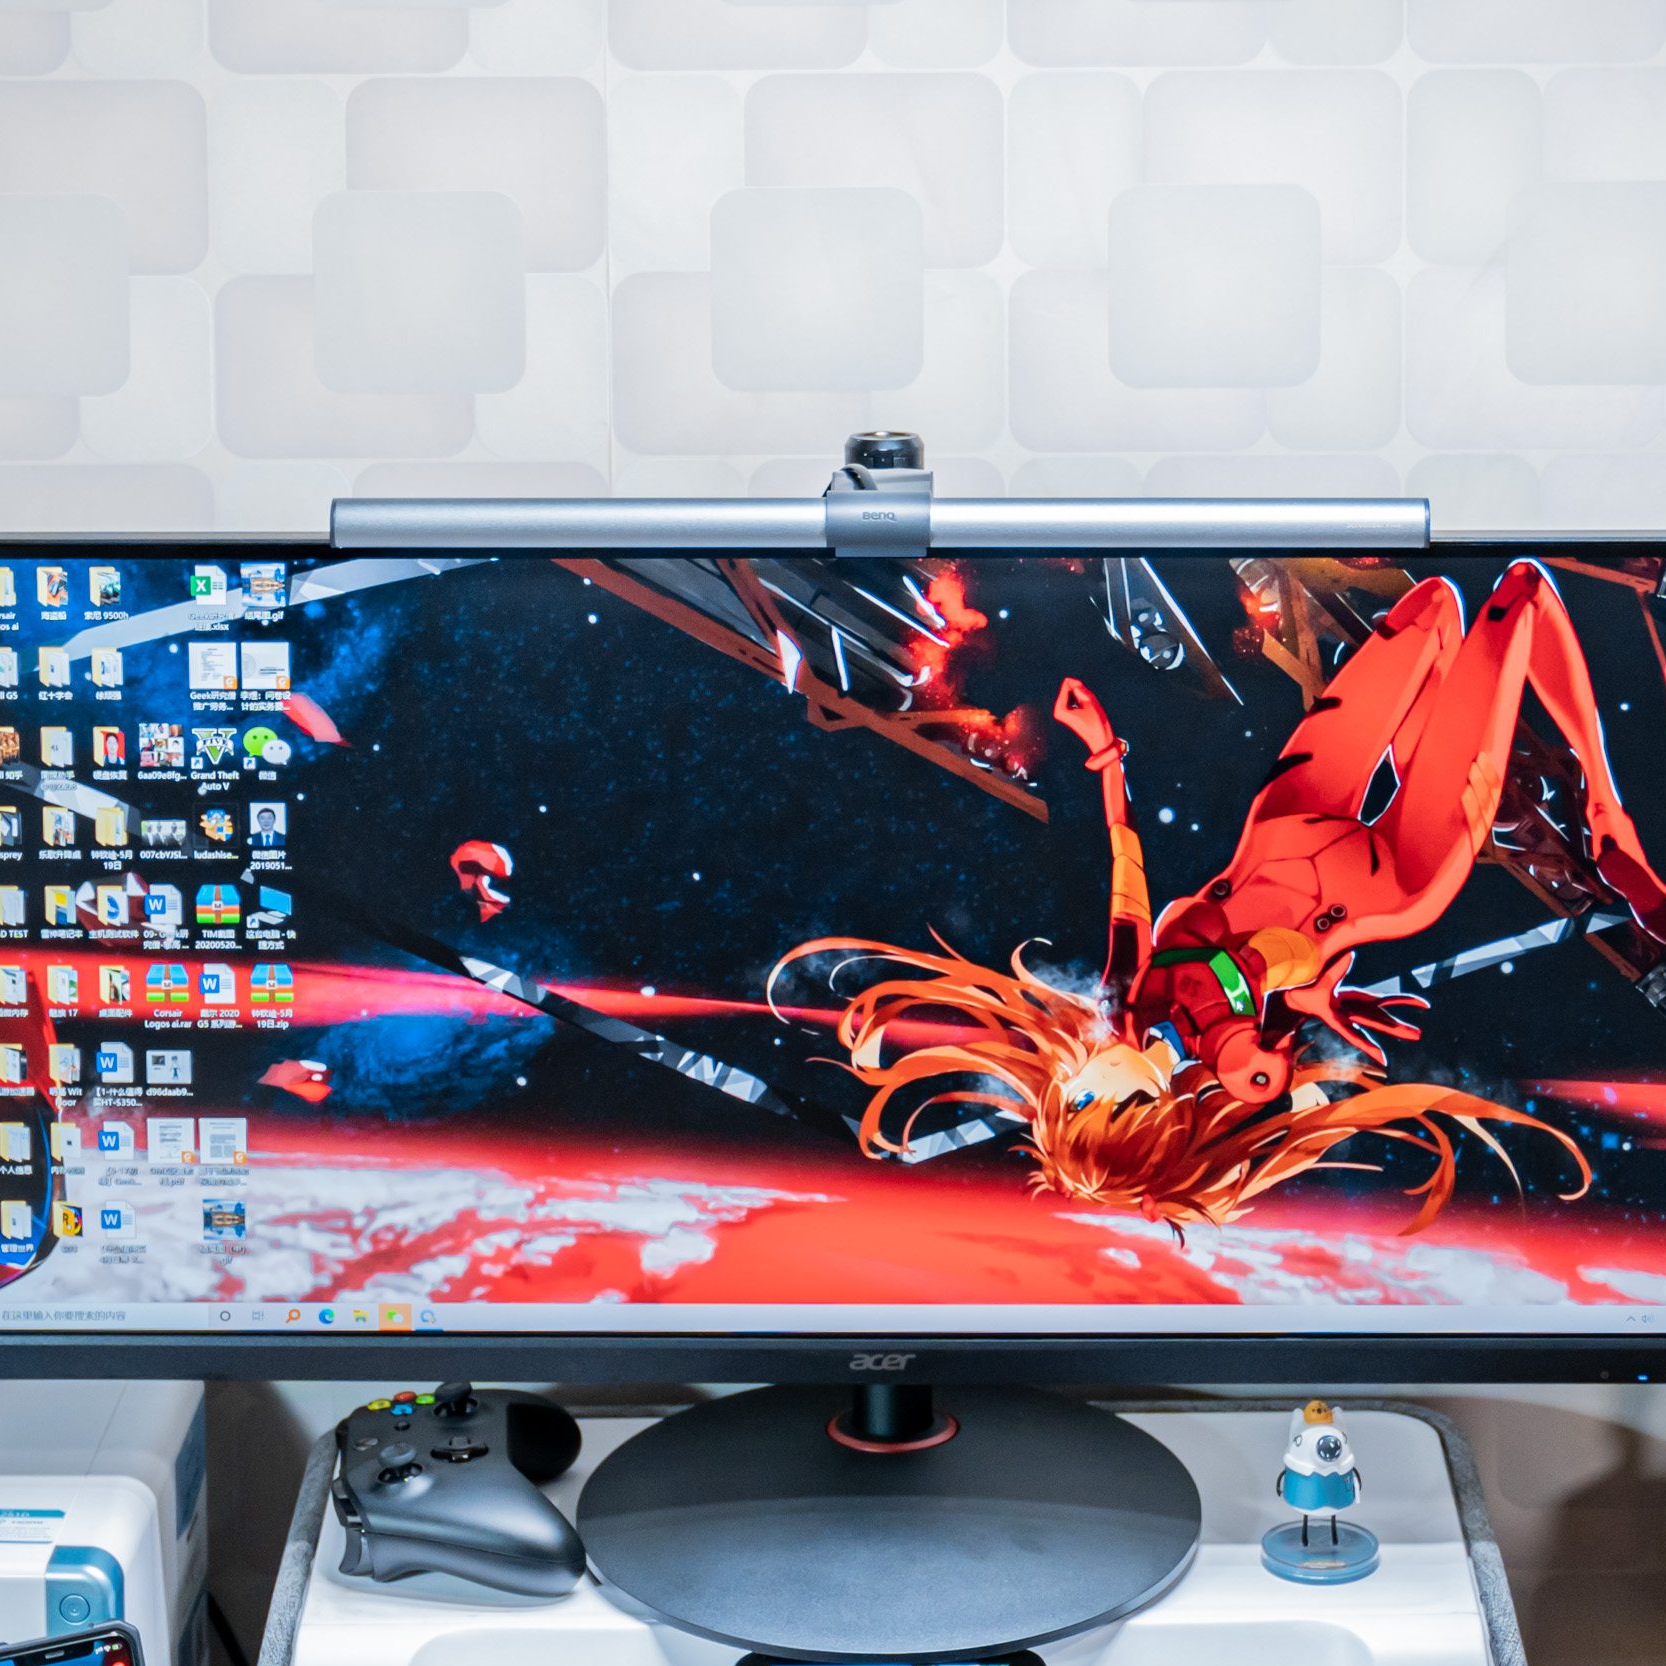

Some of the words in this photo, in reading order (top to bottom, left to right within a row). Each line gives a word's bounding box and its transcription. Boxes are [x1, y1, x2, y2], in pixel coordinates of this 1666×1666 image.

[103, 611, 130, 621] 9500h
[11, 622, 20, 631] ai
[6, 691, 18, 700] G5
[38, 690, 74, 701] 红十字会
[5, 770, 23, 780] 知乎
[190, 771, 216, 780] Grand
[217, 770, 240, 780] Theft
[258, 770, 277, 781] 微信
[201, 782, 222, 791] Auto
[222, 781, 230, 790] V
[251, 850, 287, 860] 微信图片
[103, 861, 122, 870] 19日
[8, 929, 29, 939] TEST
[245, 929, 281, 940] 这台电脑
[68, 1008, 79, 1017] 17
[153, 1008, 183, 1018] Corsair
[219, 1009, 240, 1018] 2020
[144, 1019, 171, 1030] Logos
[171, 1019, 193, 1029] ai.rar
[196, 1020, 209, 1029] G5
[849, 1353, 916, 1371] acer
